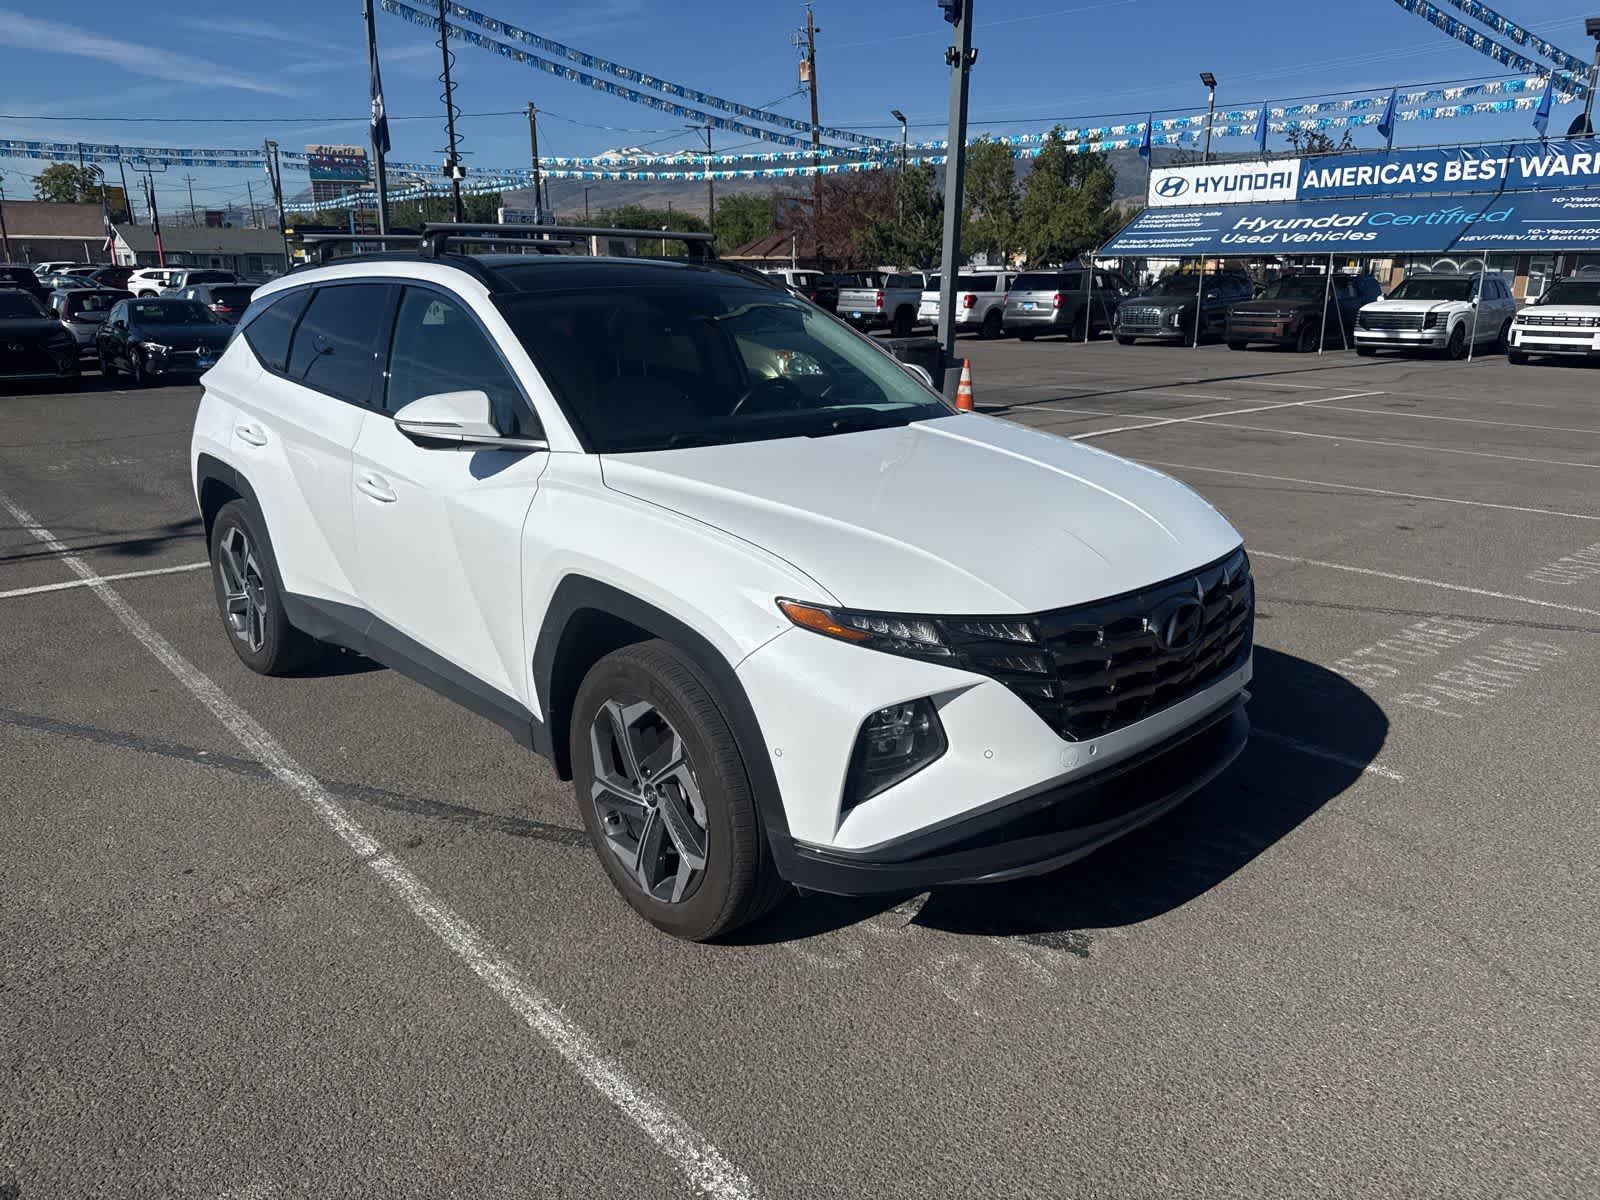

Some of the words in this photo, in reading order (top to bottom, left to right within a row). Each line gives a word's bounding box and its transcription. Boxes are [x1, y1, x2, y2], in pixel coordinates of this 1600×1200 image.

[1194, 171, 1292, 193] HYUNDAI
[1302, 161, 1438, 190] AMERICA'S
[1443, 158, 1515, 182] BEST
[1233, 212, 1369, 233] Hyundai
[1367, 205, 1515, 226] Certified
[1220, 231, 1280, 244] Used
[1281, 229, 1378, 243] Vehicles
